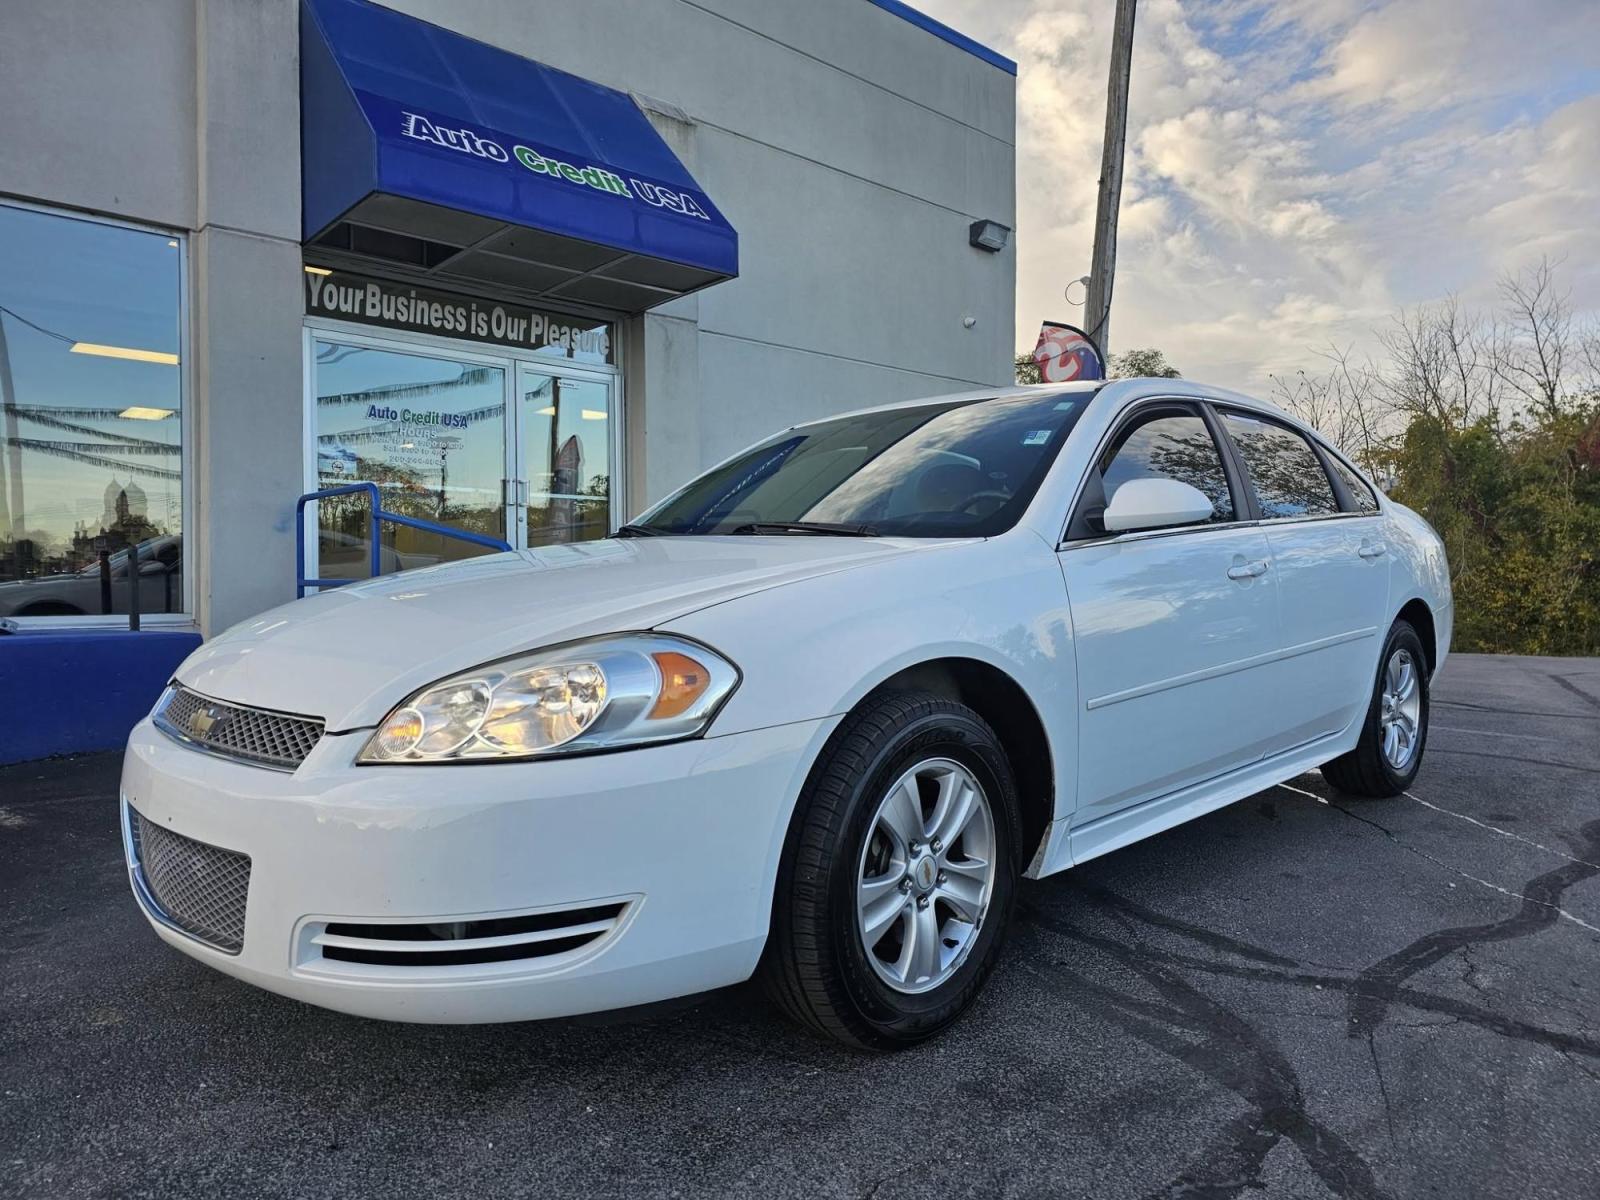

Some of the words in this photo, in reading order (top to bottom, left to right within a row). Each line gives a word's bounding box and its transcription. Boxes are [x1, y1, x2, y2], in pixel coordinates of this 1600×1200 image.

[401, 111, 509, 163] Auto
[513, 144, 633, 199] Credit
[630, 178, 710, 220] USA
[307, 275, 363, 315] Your
[365, 283, 467, 332] Business
[471, 303, 488, 338] is
[491, 306, 528, 343] Our
[530, 313, 610, 356] Pleasure
[368, 404, 398, 421] Auto
[401, 408, 440, 426] Credit
[442, 412, 468, 429] USA
